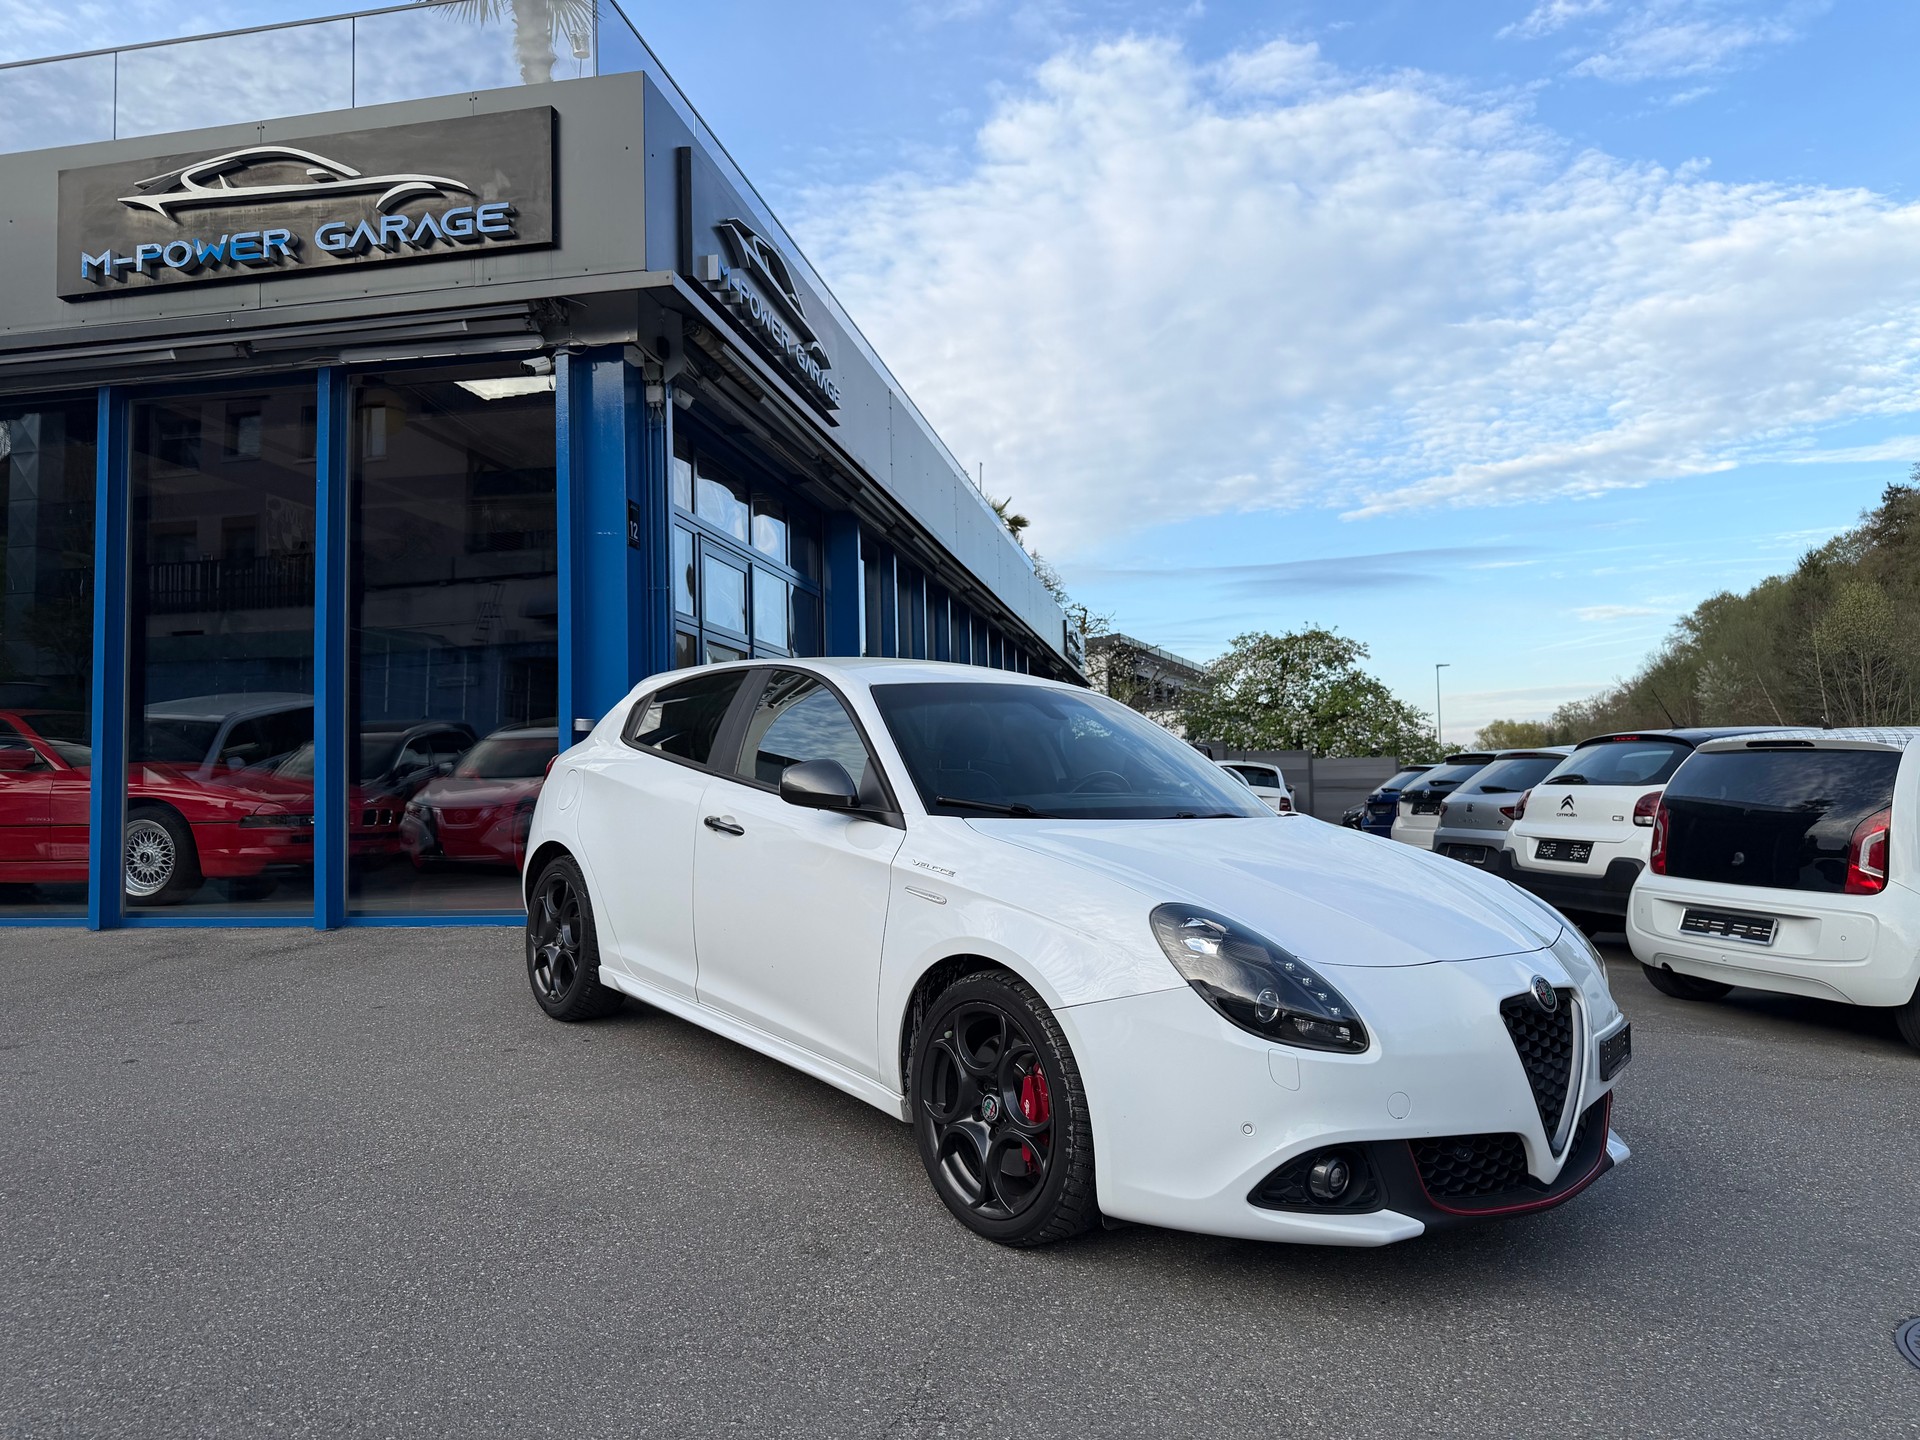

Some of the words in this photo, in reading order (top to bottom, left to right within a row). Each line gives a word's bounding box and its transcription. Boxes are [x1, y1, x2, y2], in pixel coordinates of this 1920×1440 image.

[81, 228, 291, 278] M-POWER
[314, 202, 510, 250] GARAGE
[717, 256, 791, 355] M-POWER
[795, 343, 841, 408] GARAGE
[629, 520, 639, 540] 12
